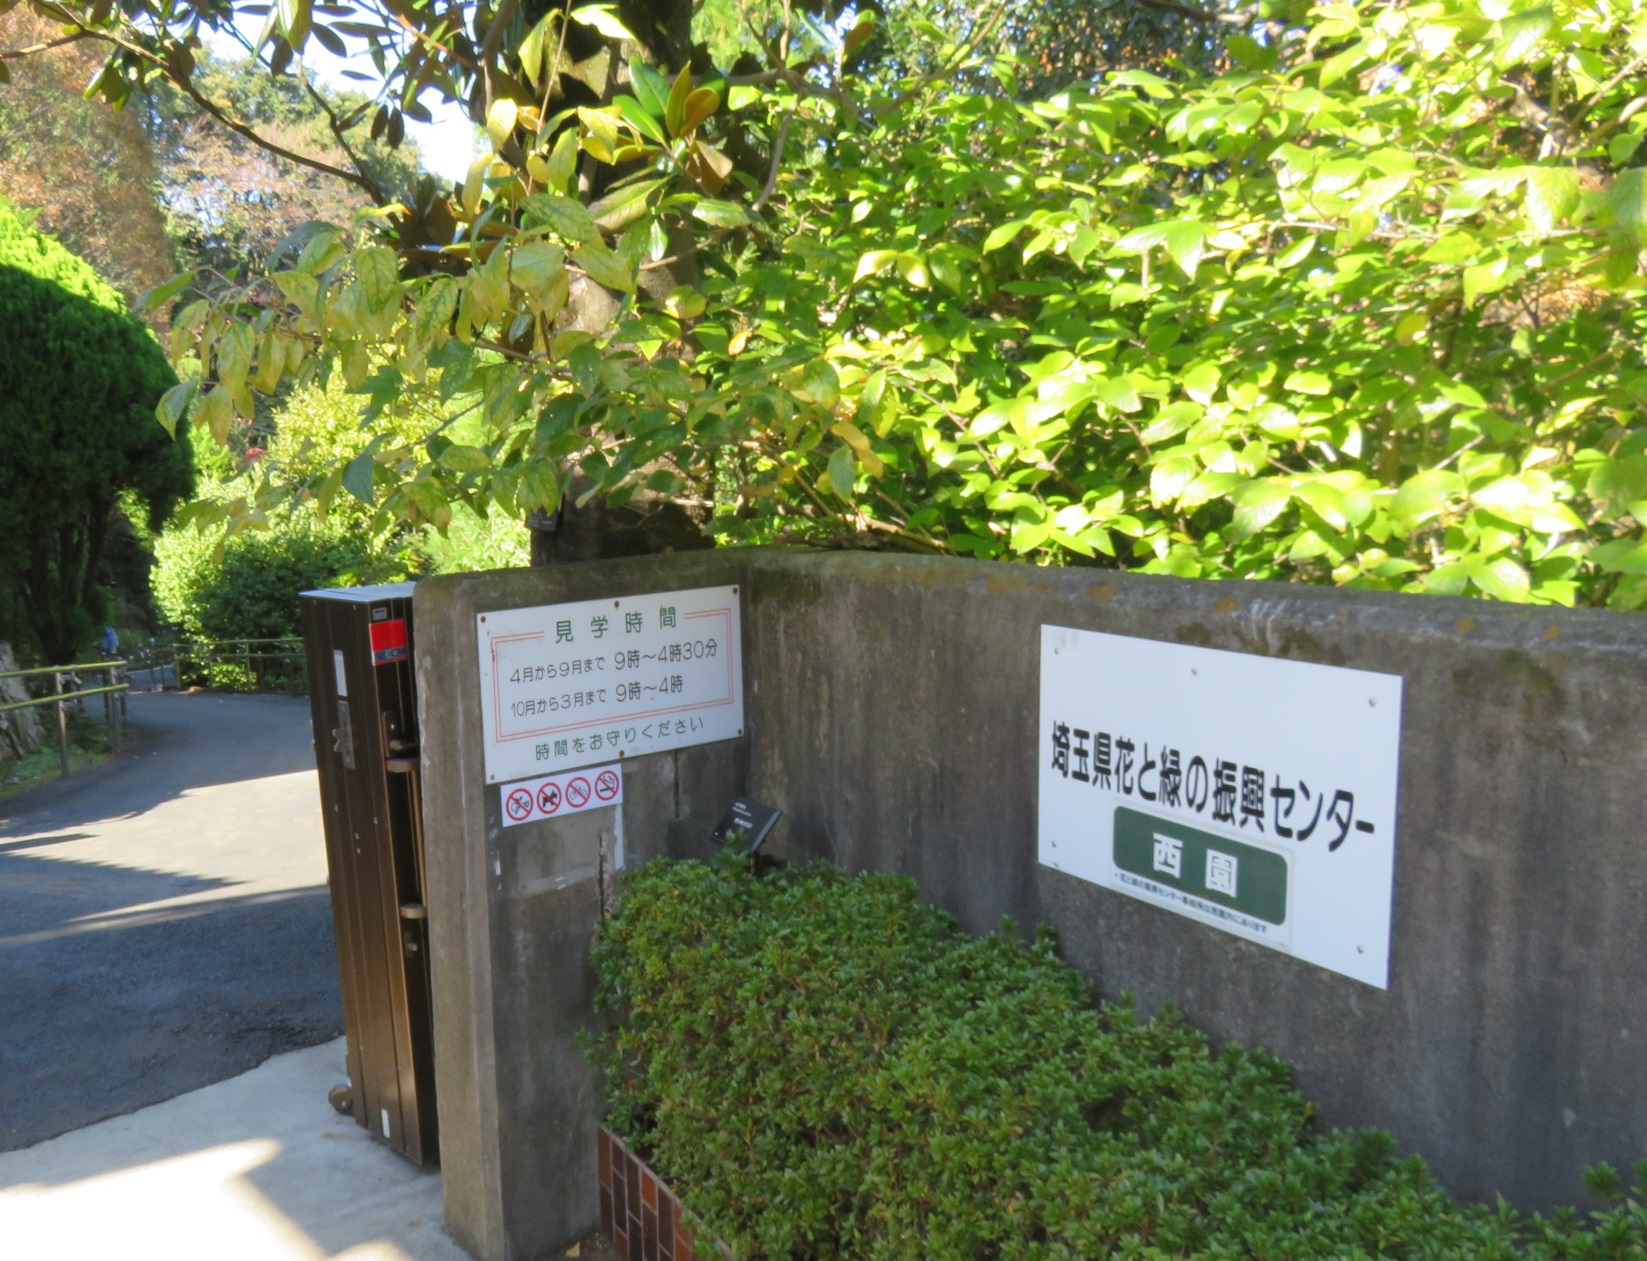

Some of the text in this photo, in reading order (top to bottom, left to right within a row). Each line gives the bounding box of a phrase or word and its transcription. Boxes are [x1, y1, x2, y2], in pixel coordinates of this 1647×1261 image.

[555, 607, 676, 644] 見学時間
[510, 656, 605, 684] 4月から9月まで
[511, 688, 606, 718] 10月から3月まで
[535, 716, 704, 761] 時間をお守りください
[1051, 720, 1375, 853] 埼玉県花と緑の振興センター
[1152, 832, 1238, 899] 西園
